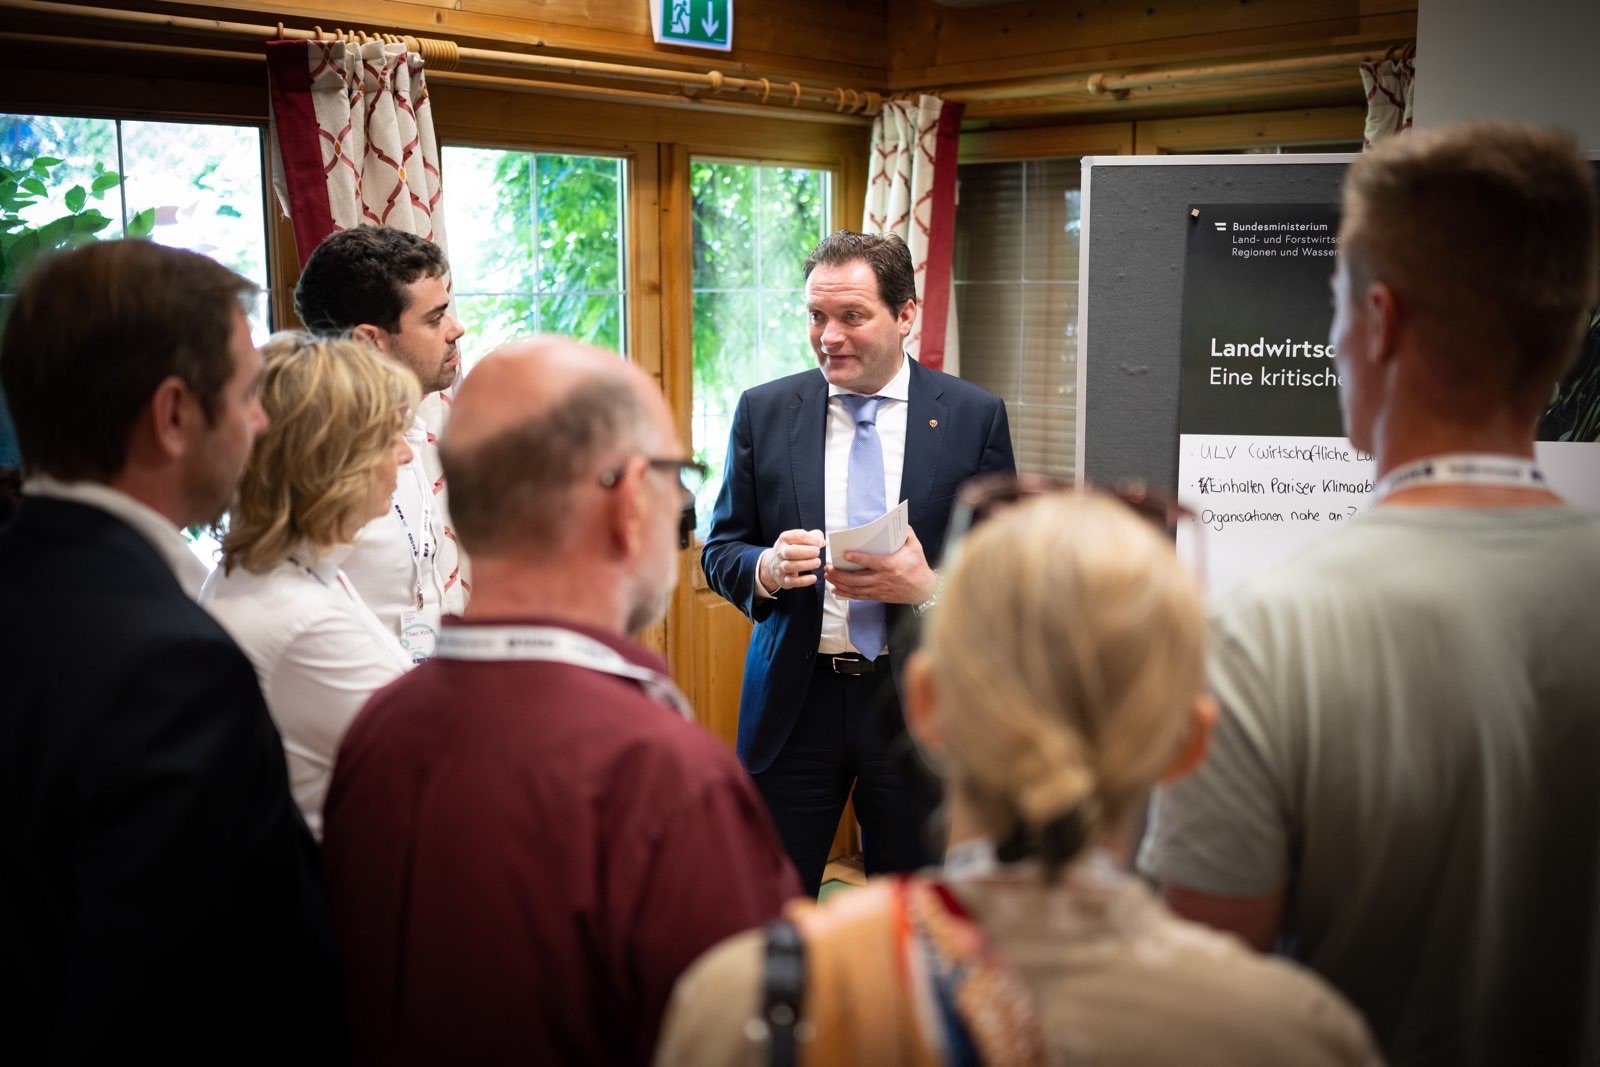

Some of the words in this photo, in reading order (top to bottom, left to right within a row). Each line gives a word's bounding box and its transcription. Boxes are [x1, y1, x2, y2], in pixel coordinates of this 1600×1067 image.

[1232, 222, 1328, 231] Bundesministerium
[1232, 235, 1260, 244] Land-
[1263, 235, 1282, 244] und
[1285, 235, 1342, 244] Forstwirtsc
[1232, 247, 1277, 258] Regionen
[1280, 247, 1299, 257] und
[1302, 247, 1340, 257] Wasser
[1211, 337, 1337, 358] Landwirtsc
[1210, 367, 1253, 386] Eine
[1271, 478, 1317, 495] Pariser
[1290, 510, 1321, 522] nahe
